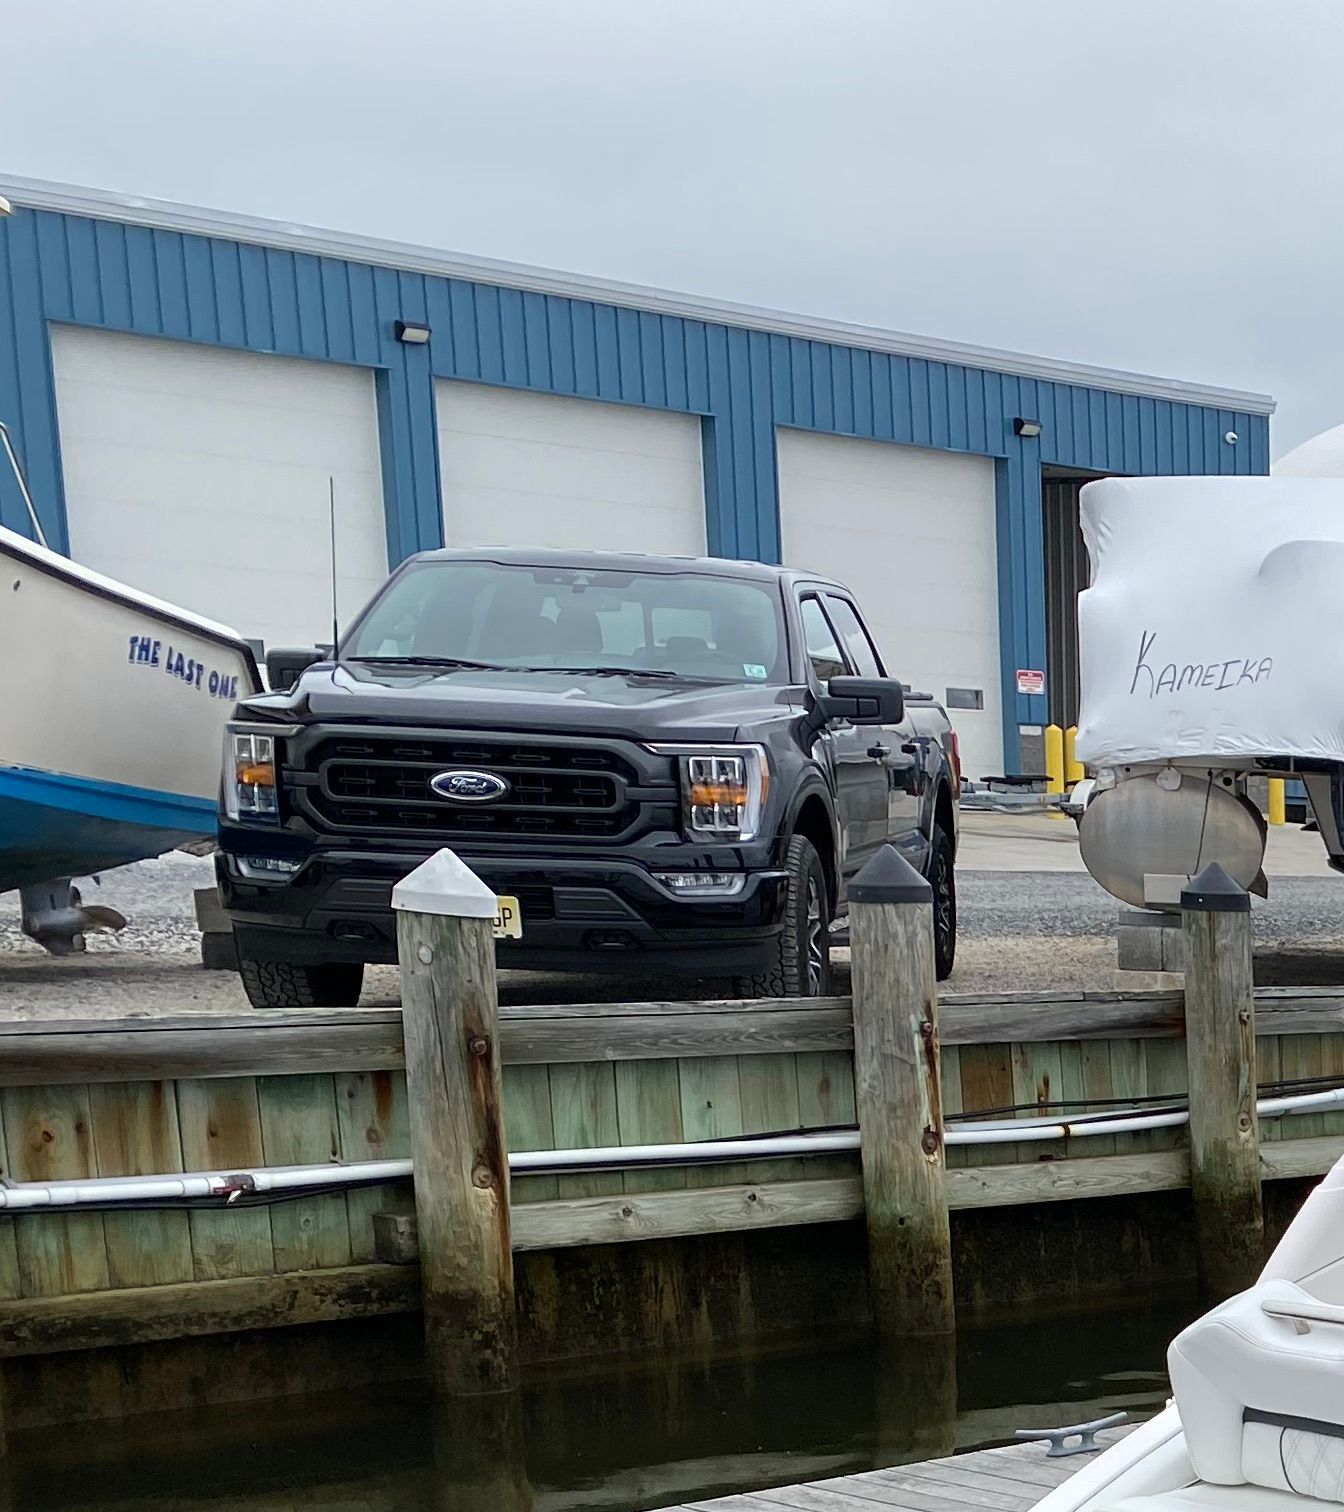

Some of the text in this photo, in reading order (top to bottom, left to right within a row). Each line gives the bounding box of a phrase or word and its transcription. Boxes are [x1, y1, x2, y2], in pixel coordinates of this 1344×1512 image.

[128, 635, 238, 700] THE LAST ONE
